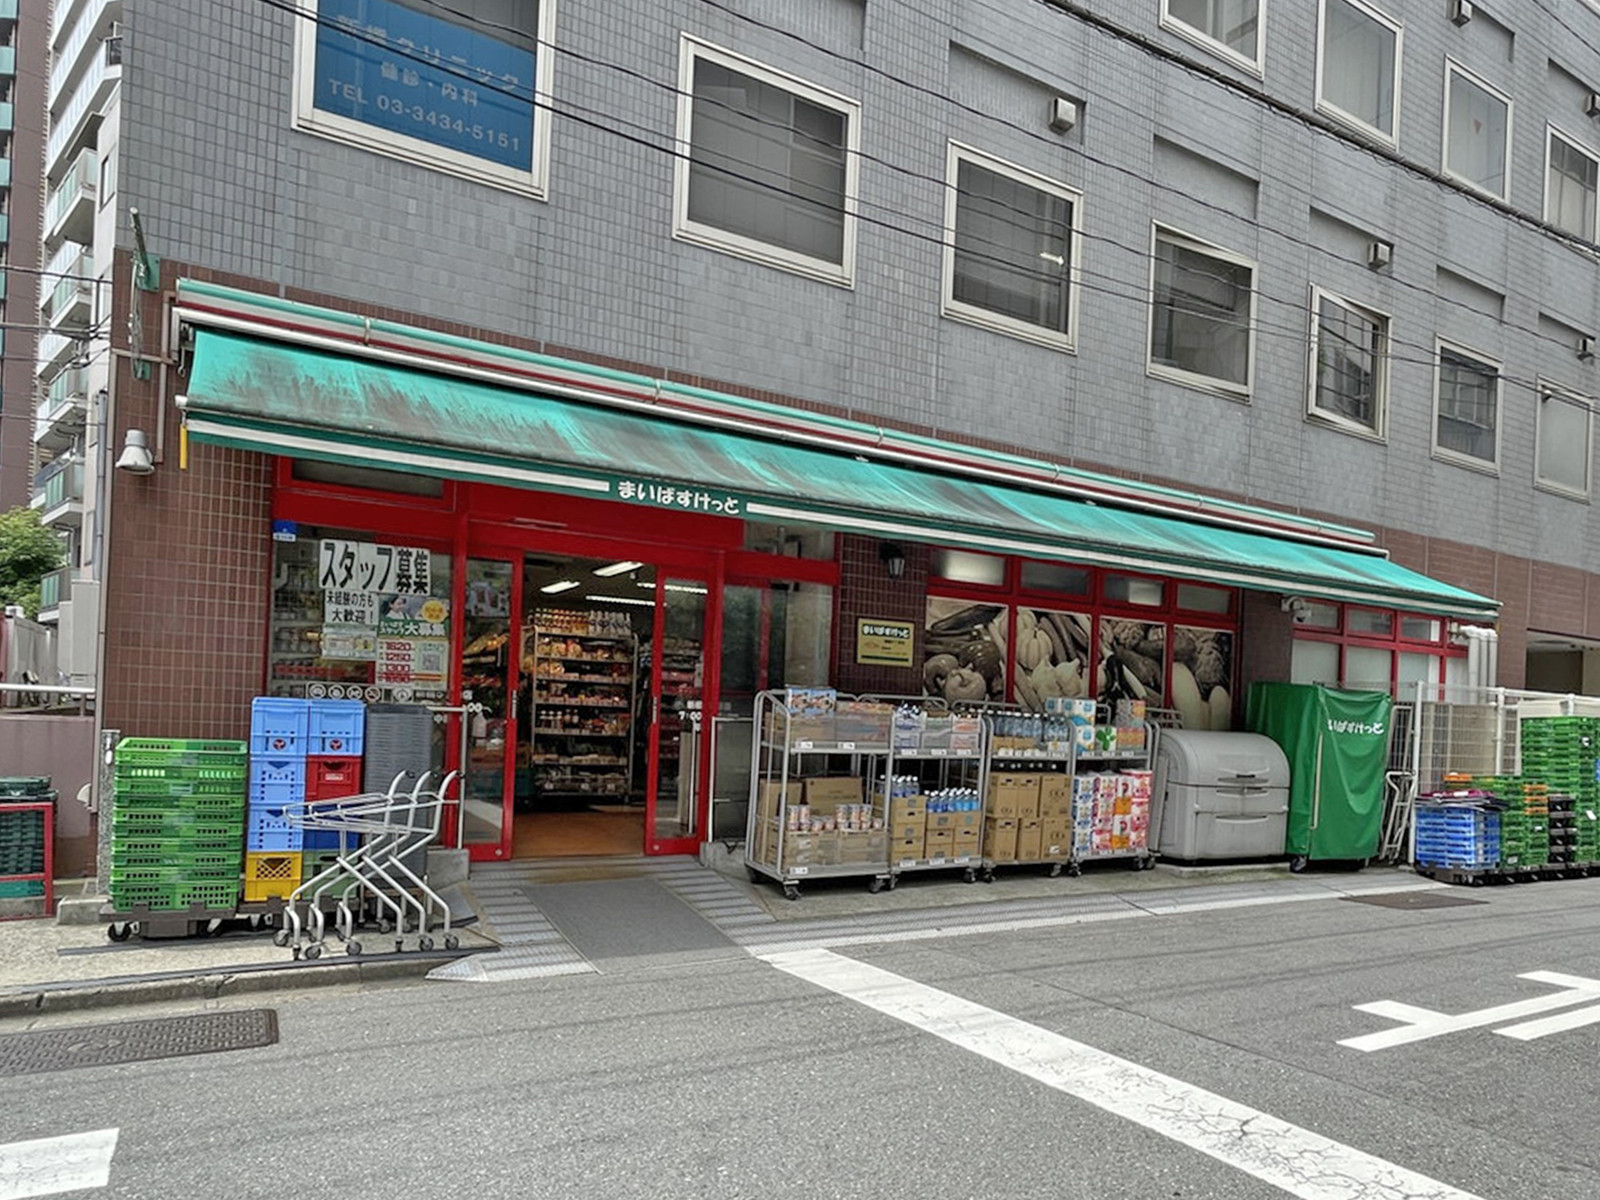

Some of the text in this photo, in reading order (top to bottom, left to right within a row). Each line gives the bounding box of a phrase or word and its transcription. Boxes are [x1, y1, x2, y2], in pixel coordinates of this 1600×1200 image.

[328, 79, 519, 151] TEL 03-3434-5151
[618, 480, 740, 514] まいばすけっと
[322, 541, 429, 594] スタッフ募集
